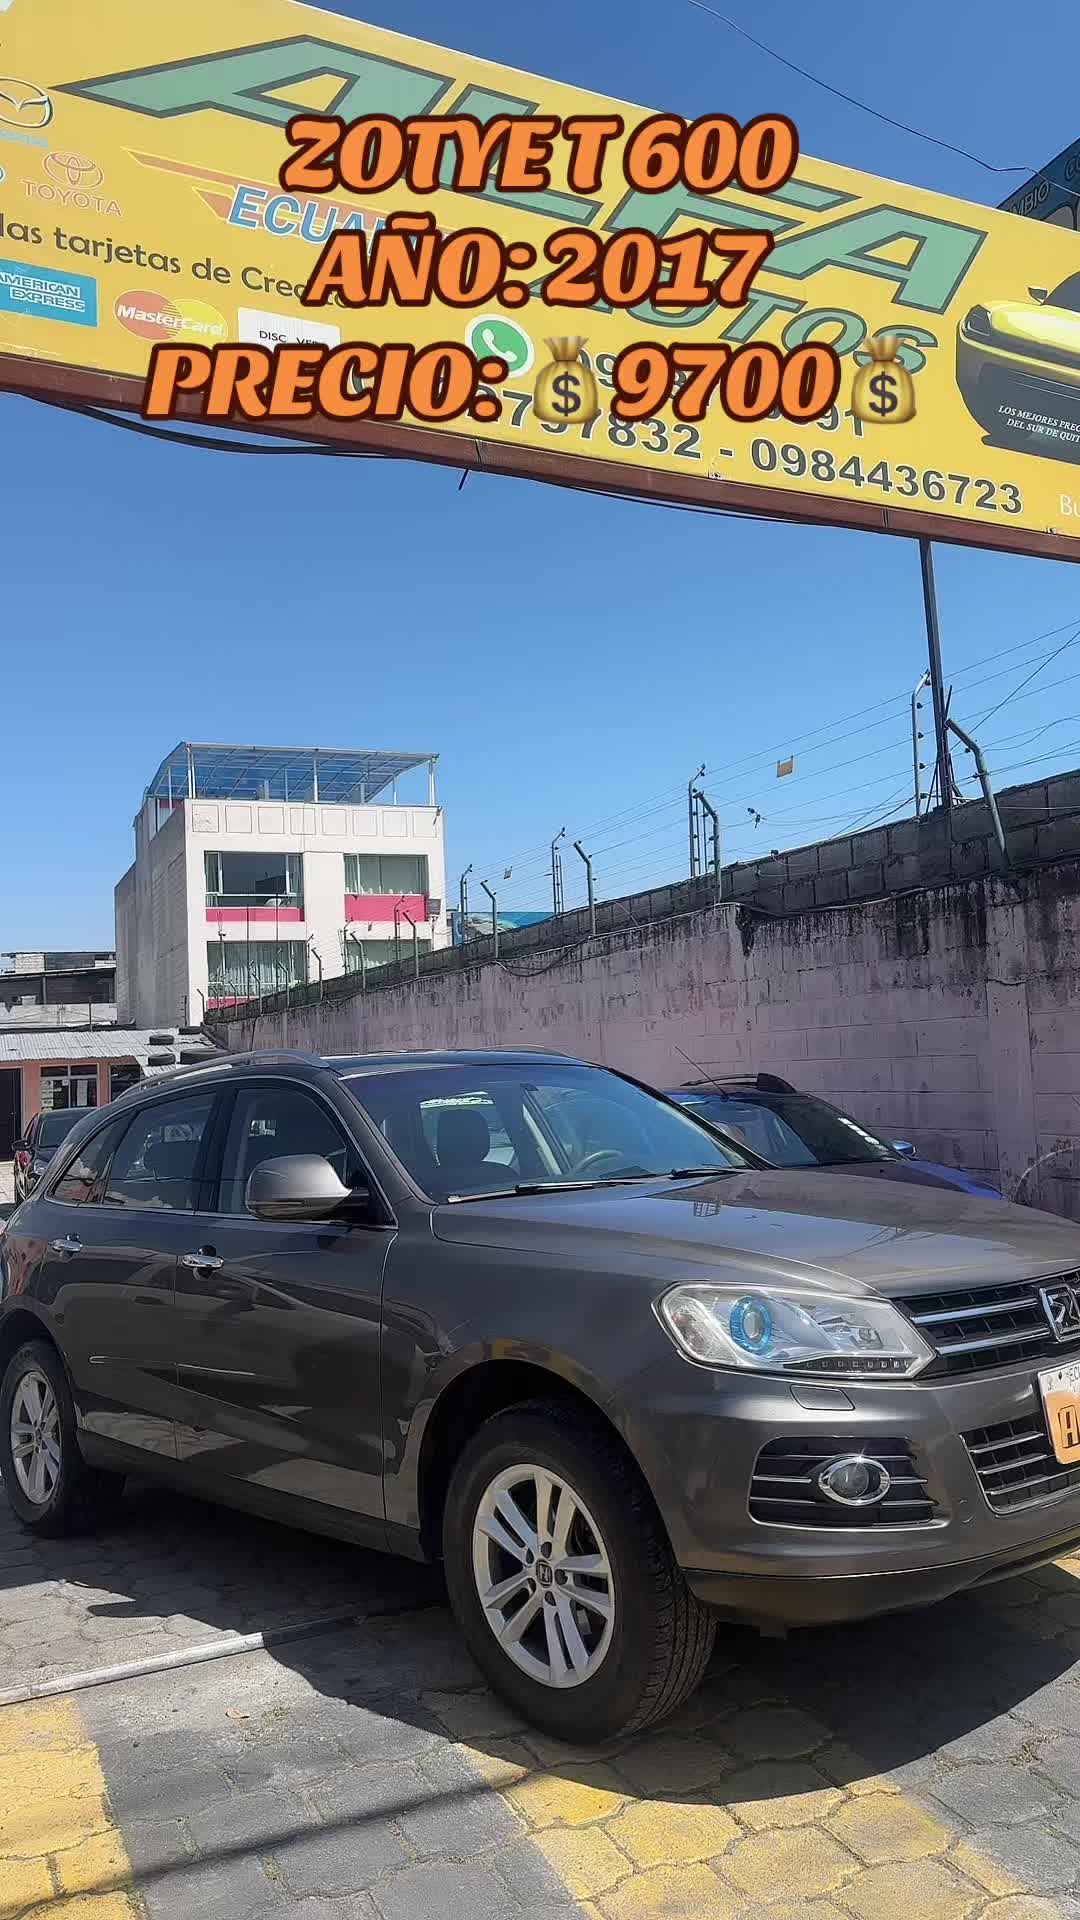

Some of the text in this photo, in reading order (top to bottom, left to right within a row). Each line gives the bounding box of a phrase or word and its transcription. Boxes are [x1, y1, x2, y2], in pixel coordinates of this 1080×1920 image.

[20, 178, 123, 216] TOYOTA
[54, 226, 182, 273] tarjetas
[191, 257, 231, 284] de
[11, 287, 86, 312] EXPRESS
[118, 304, 225, 336] MasterCard
[998, 405, 1017, 416] LOS
[1017, 410, 1059, 427] MEJORES
[1006, 418, 1026, 430] DEL
[1026, 423, 1044, 434] SUR
[1044, 427, 1060, 438] DE
[750, 437, 1024, 516] 0984436723
